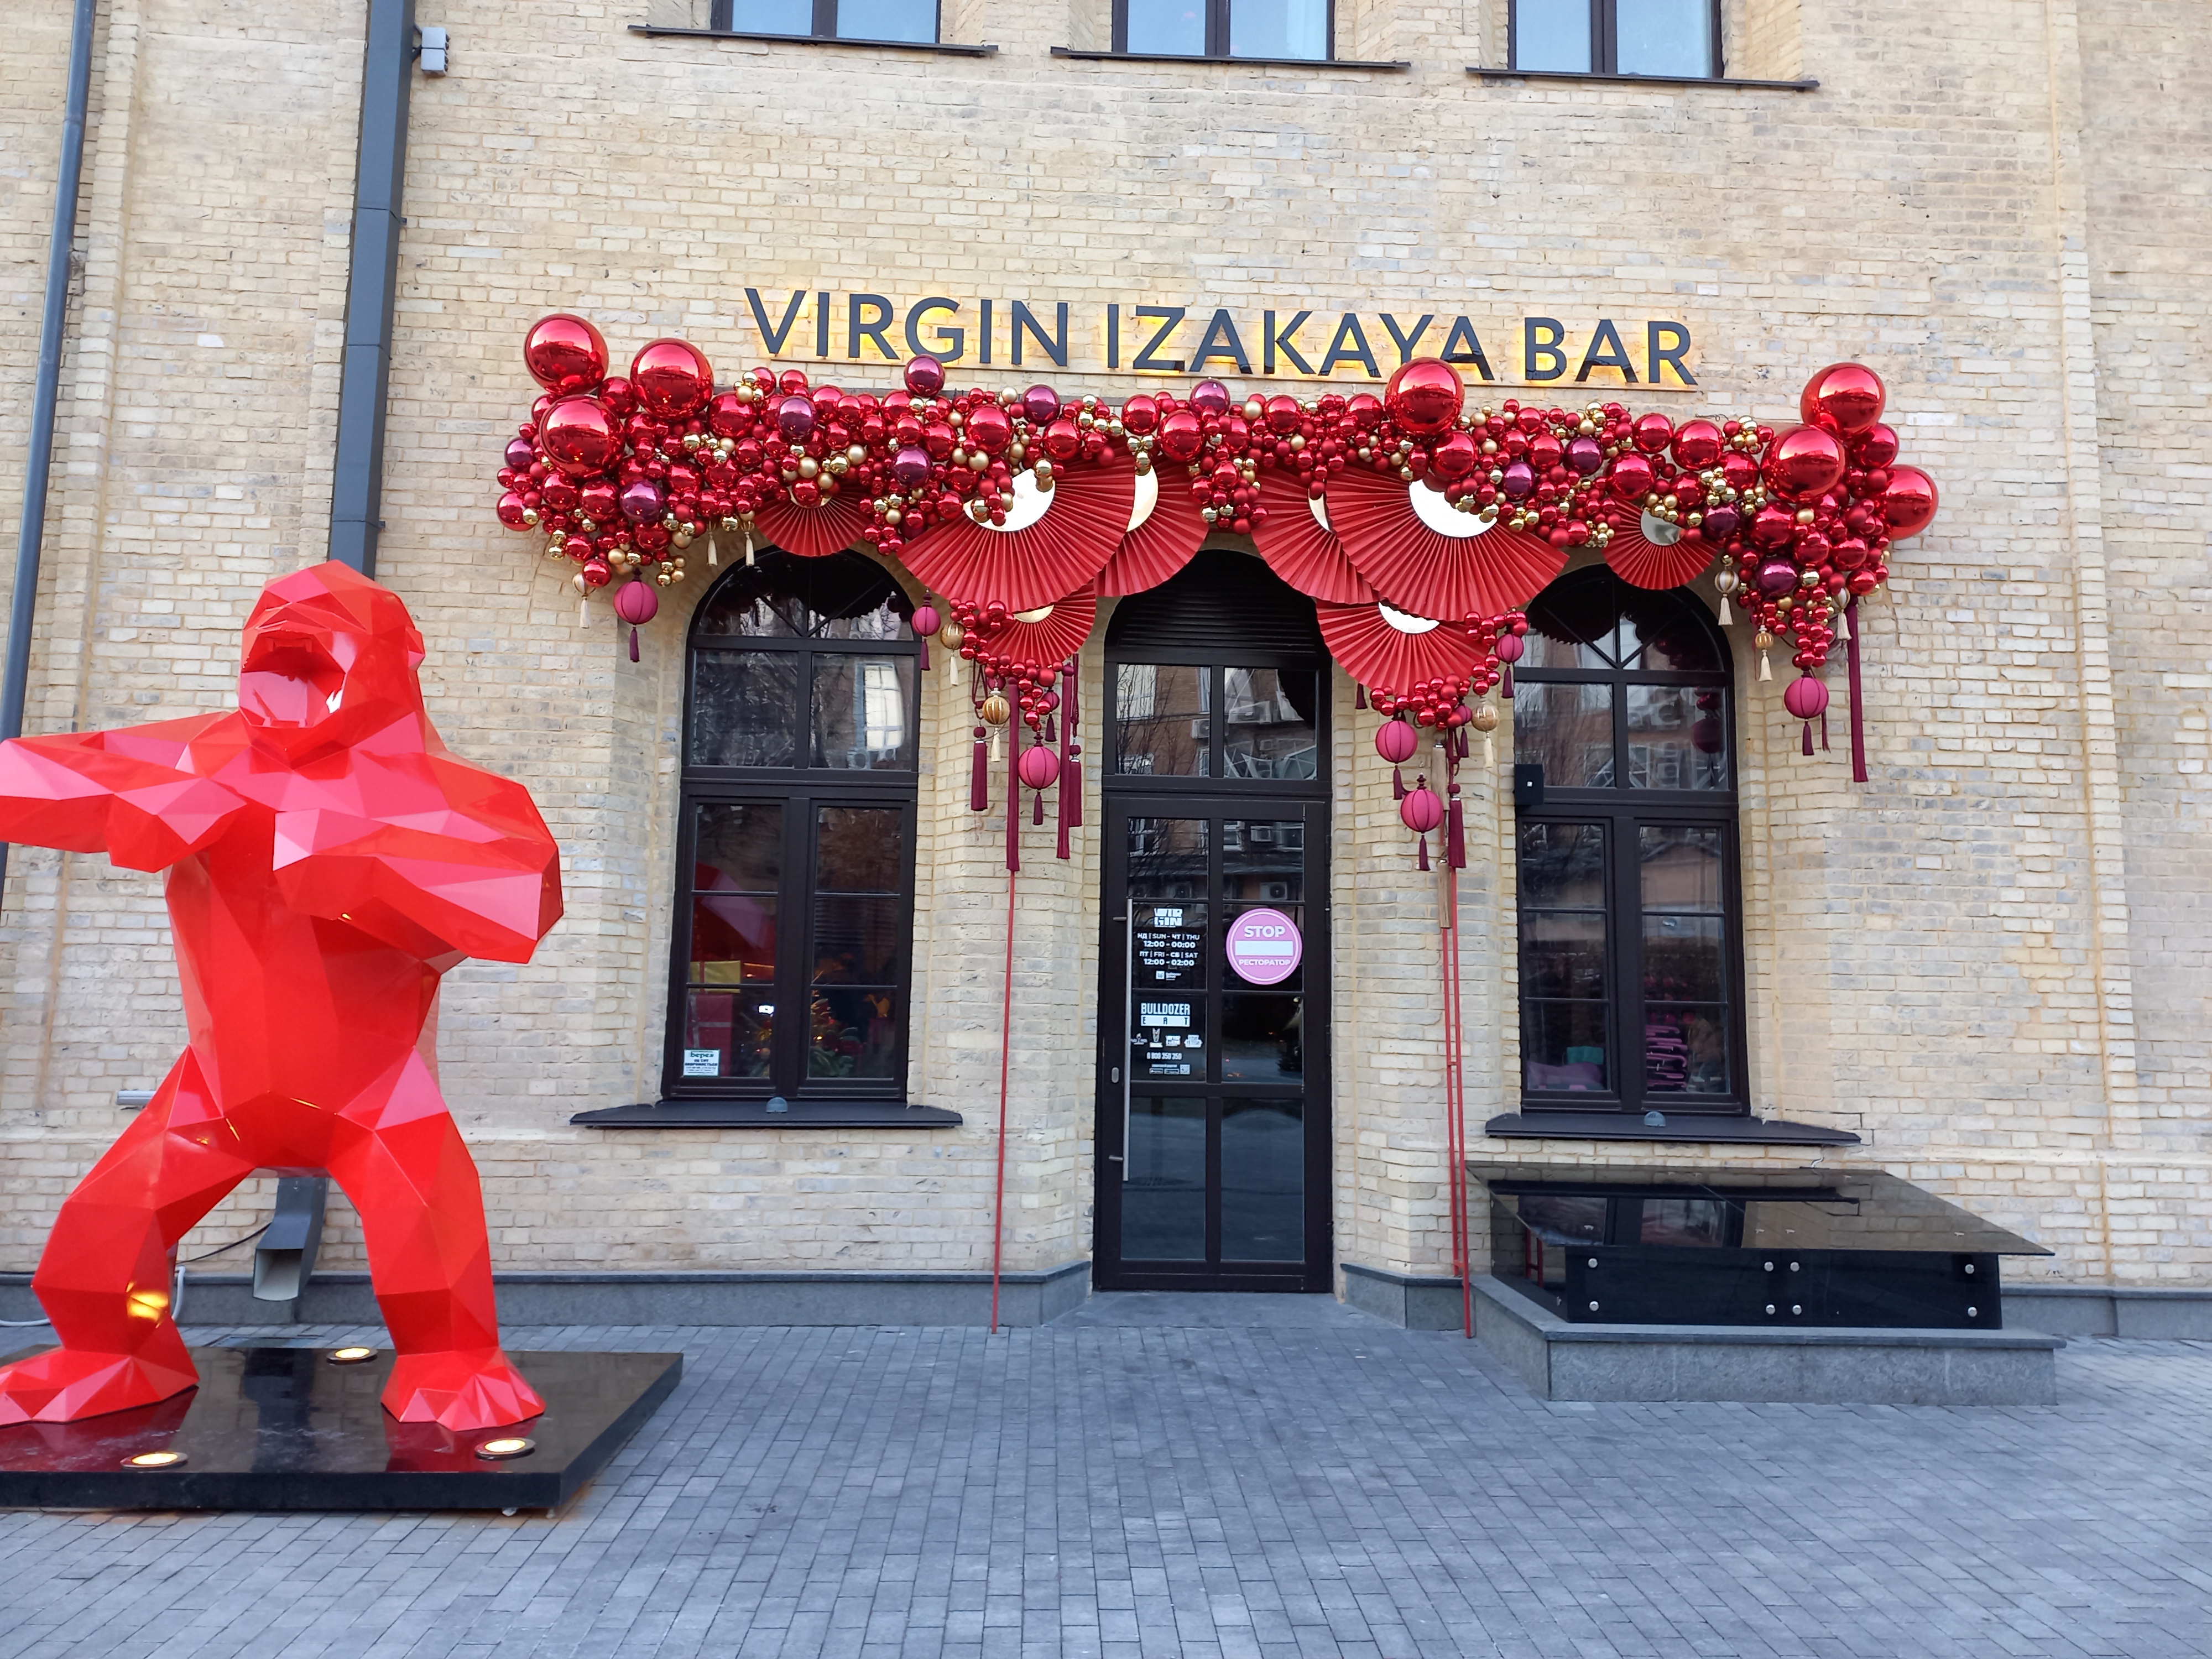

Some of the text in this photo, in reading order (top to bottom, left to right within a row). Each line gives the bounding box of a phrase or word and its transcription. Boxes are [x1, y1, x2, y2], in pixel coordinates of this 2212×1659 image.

[744, 288, 1698, 385] VIRGIN IZAKAYA BAR
[1244, 925, 1285, 938] STOP
[1141, 1003, 1191, 1015] BULLDOZER
